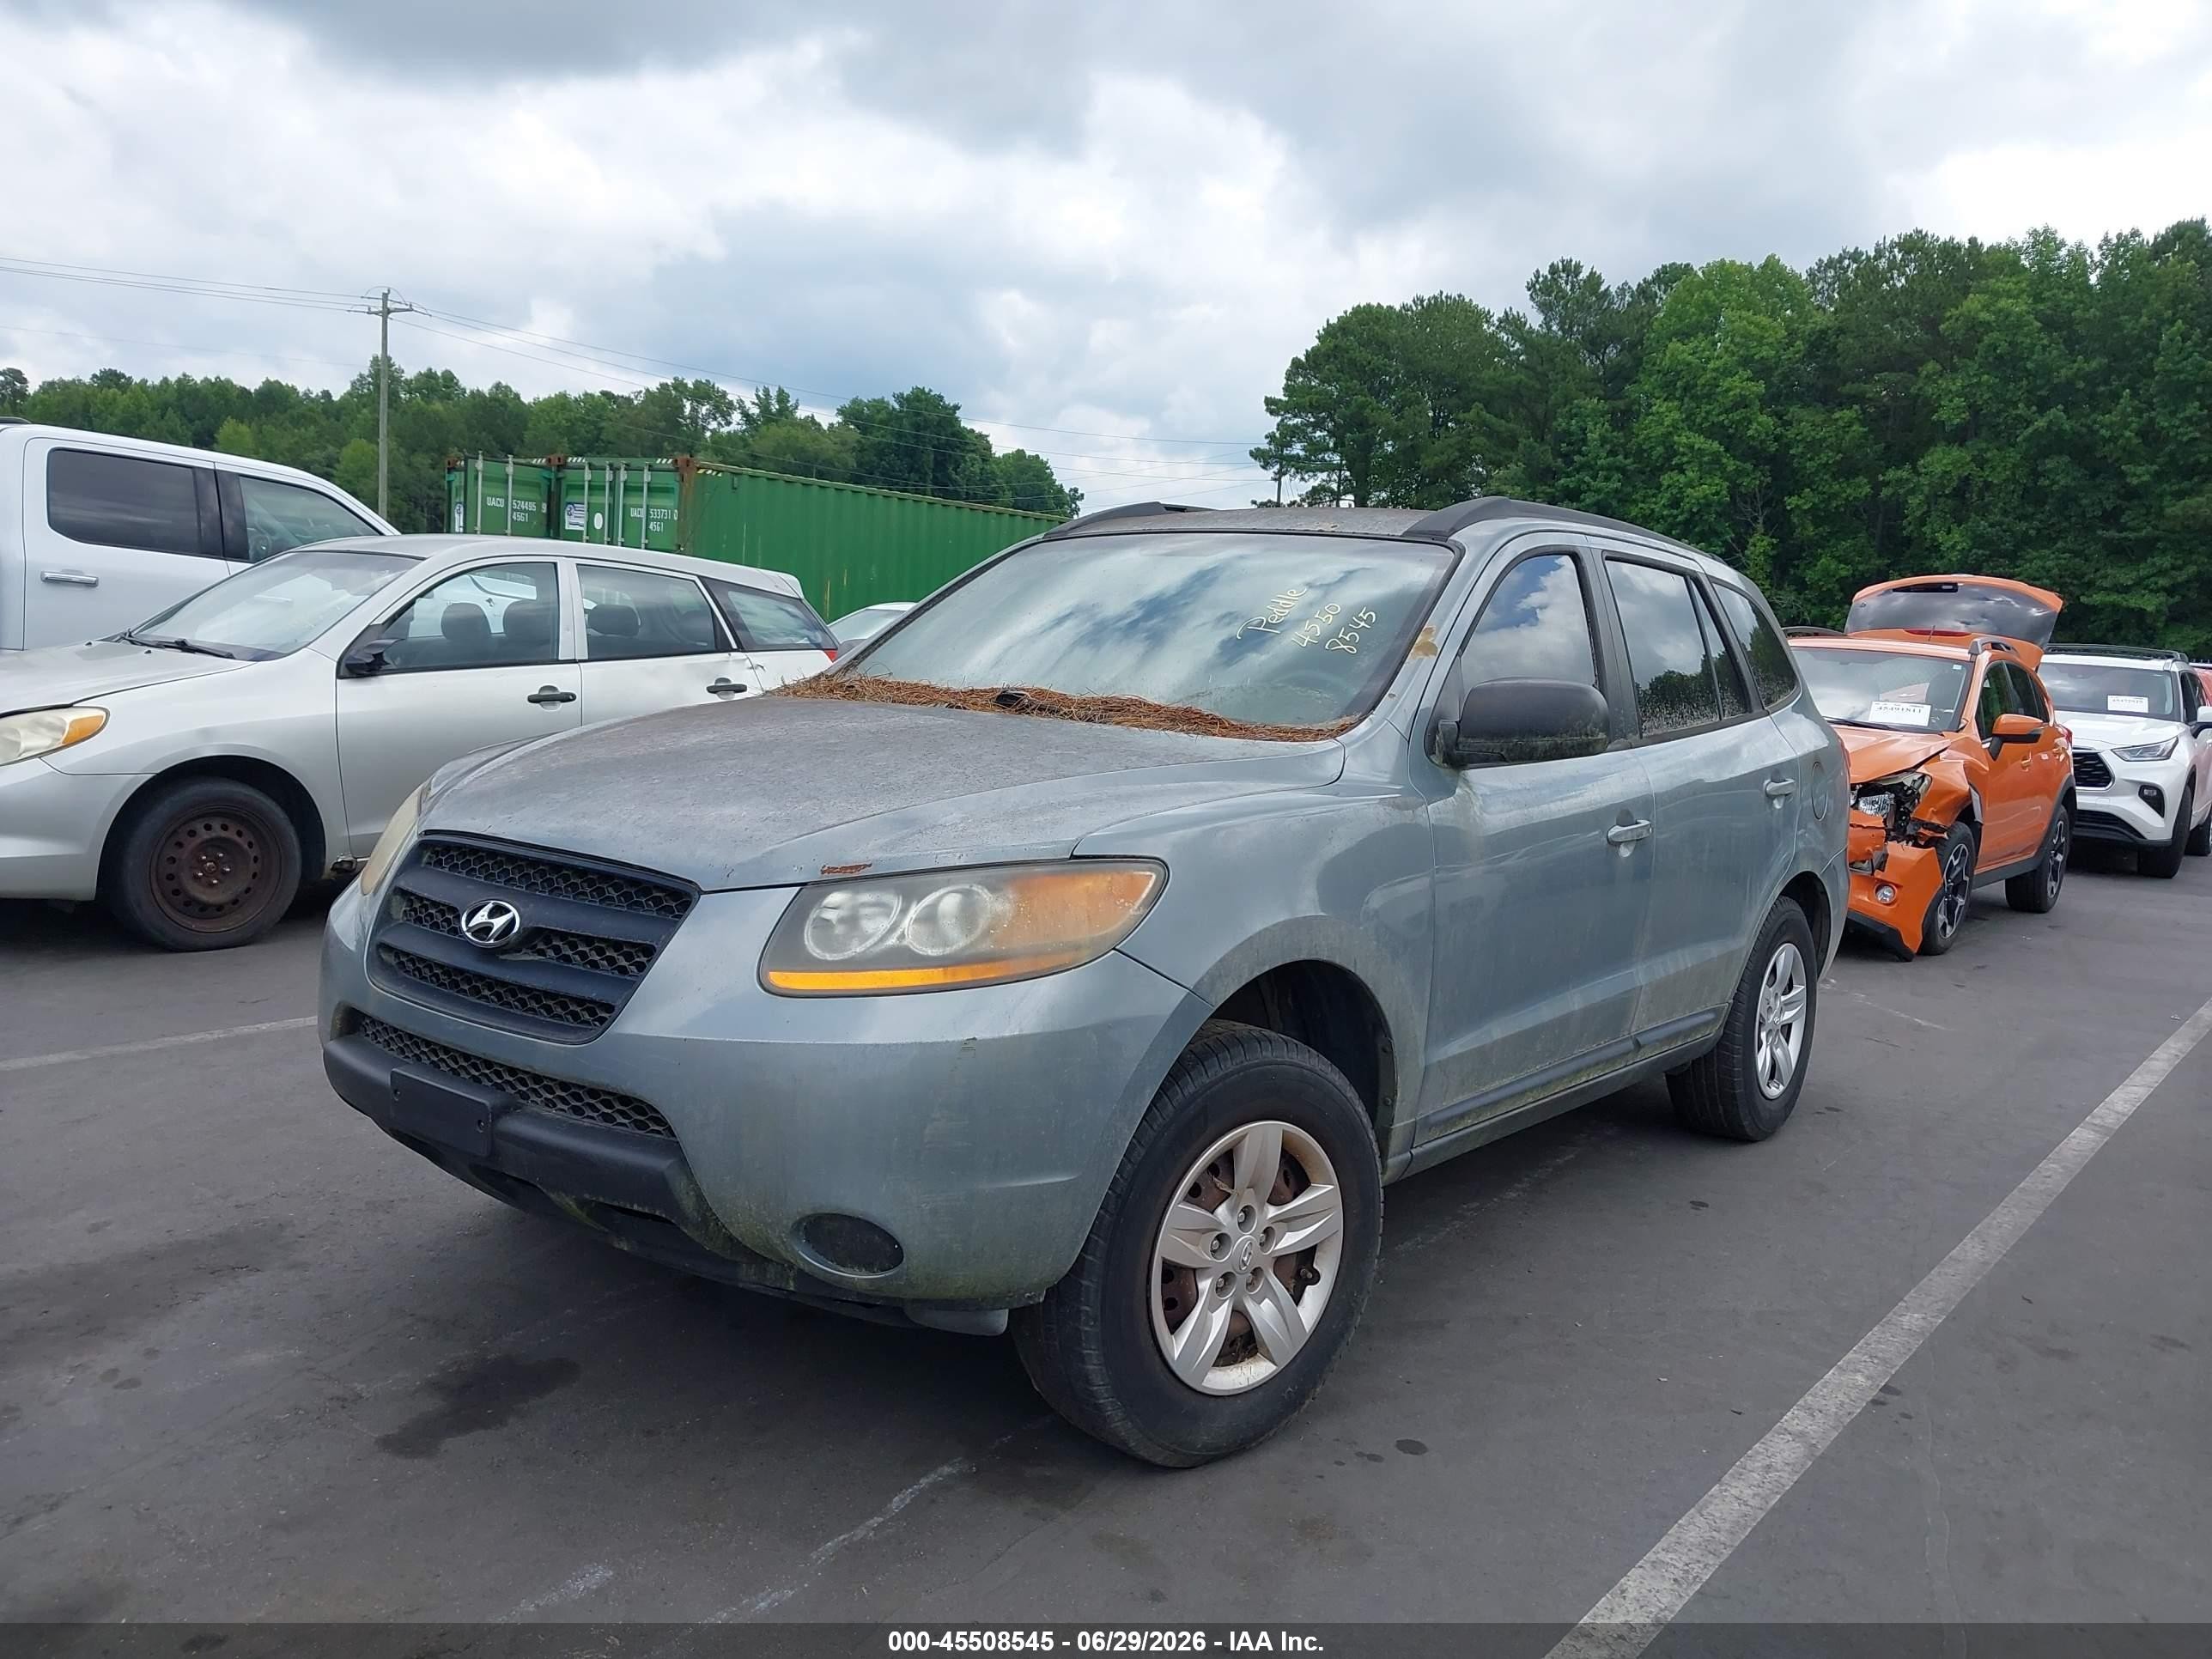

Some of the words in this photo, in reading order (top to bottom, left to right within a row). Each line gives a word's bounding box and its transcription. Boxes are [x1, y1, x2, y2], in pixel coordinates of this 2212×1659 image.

[486, 496, 505, 508] UACU
[649, 508, 672, 520] 533731
[1236, 587, 1308, 640] Peddle
[1291, 603, 1341, 647] 4550
[1325, 606, 1376, 655] 8545
